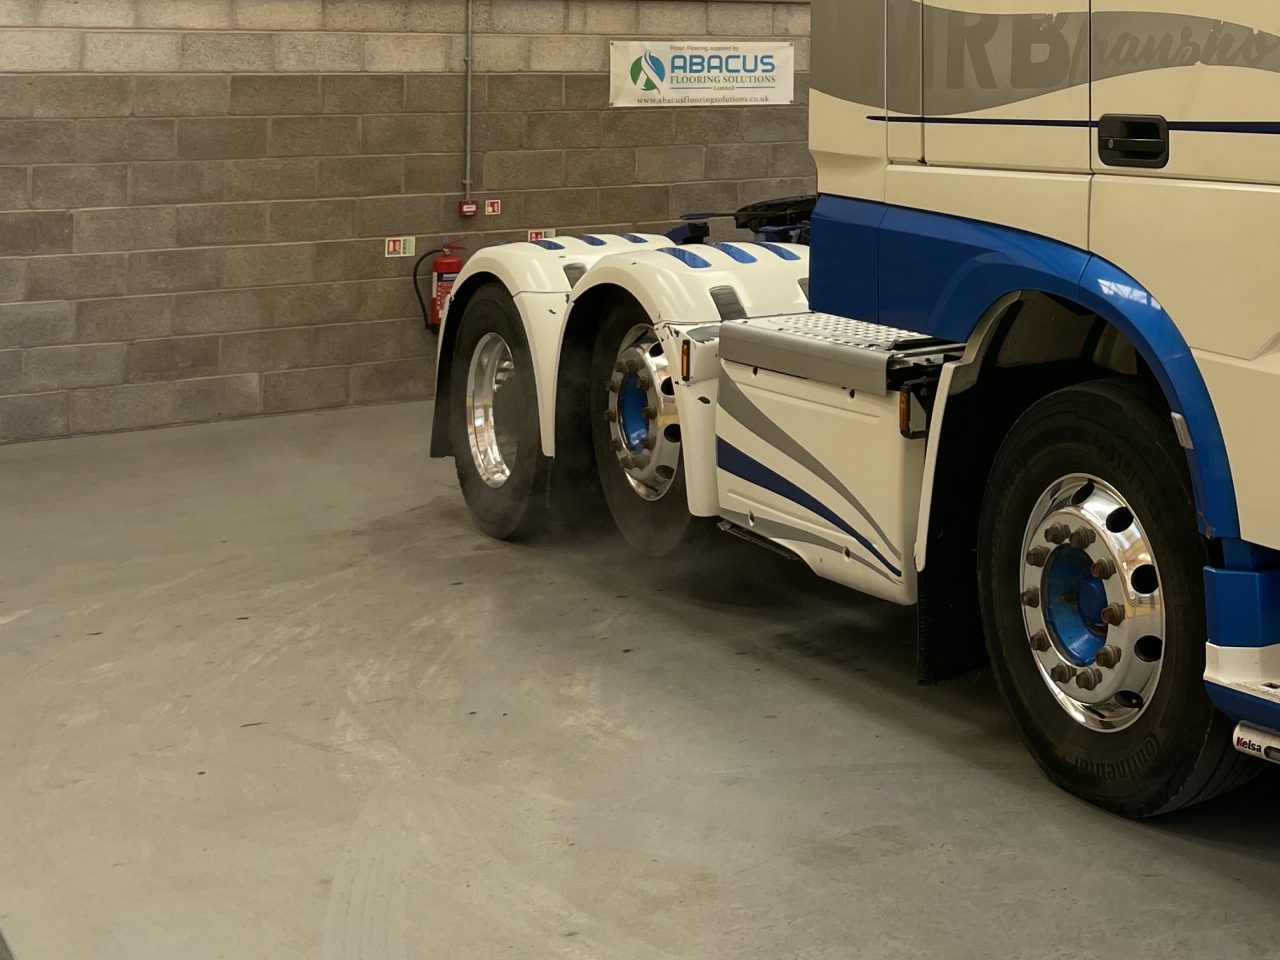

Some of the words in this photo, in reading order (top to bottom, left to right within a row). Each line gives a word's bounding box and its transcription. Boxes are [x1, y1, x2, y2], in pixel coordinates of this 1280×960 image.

[687, 45, 709, 53] Flooring
[709, 45, 730, 53] supplied
[731, 45, 740, 53] by
[670, 54, 776, 74] ABACUS
[670, 75, 721, 84] FLOORING
[723, 75, 776, 84] SOLUTIONS
[636, 94, 770, 105] www.abacusflooringsolutions.co.uk
[1236, 736, 1262, 753] Kelsa
